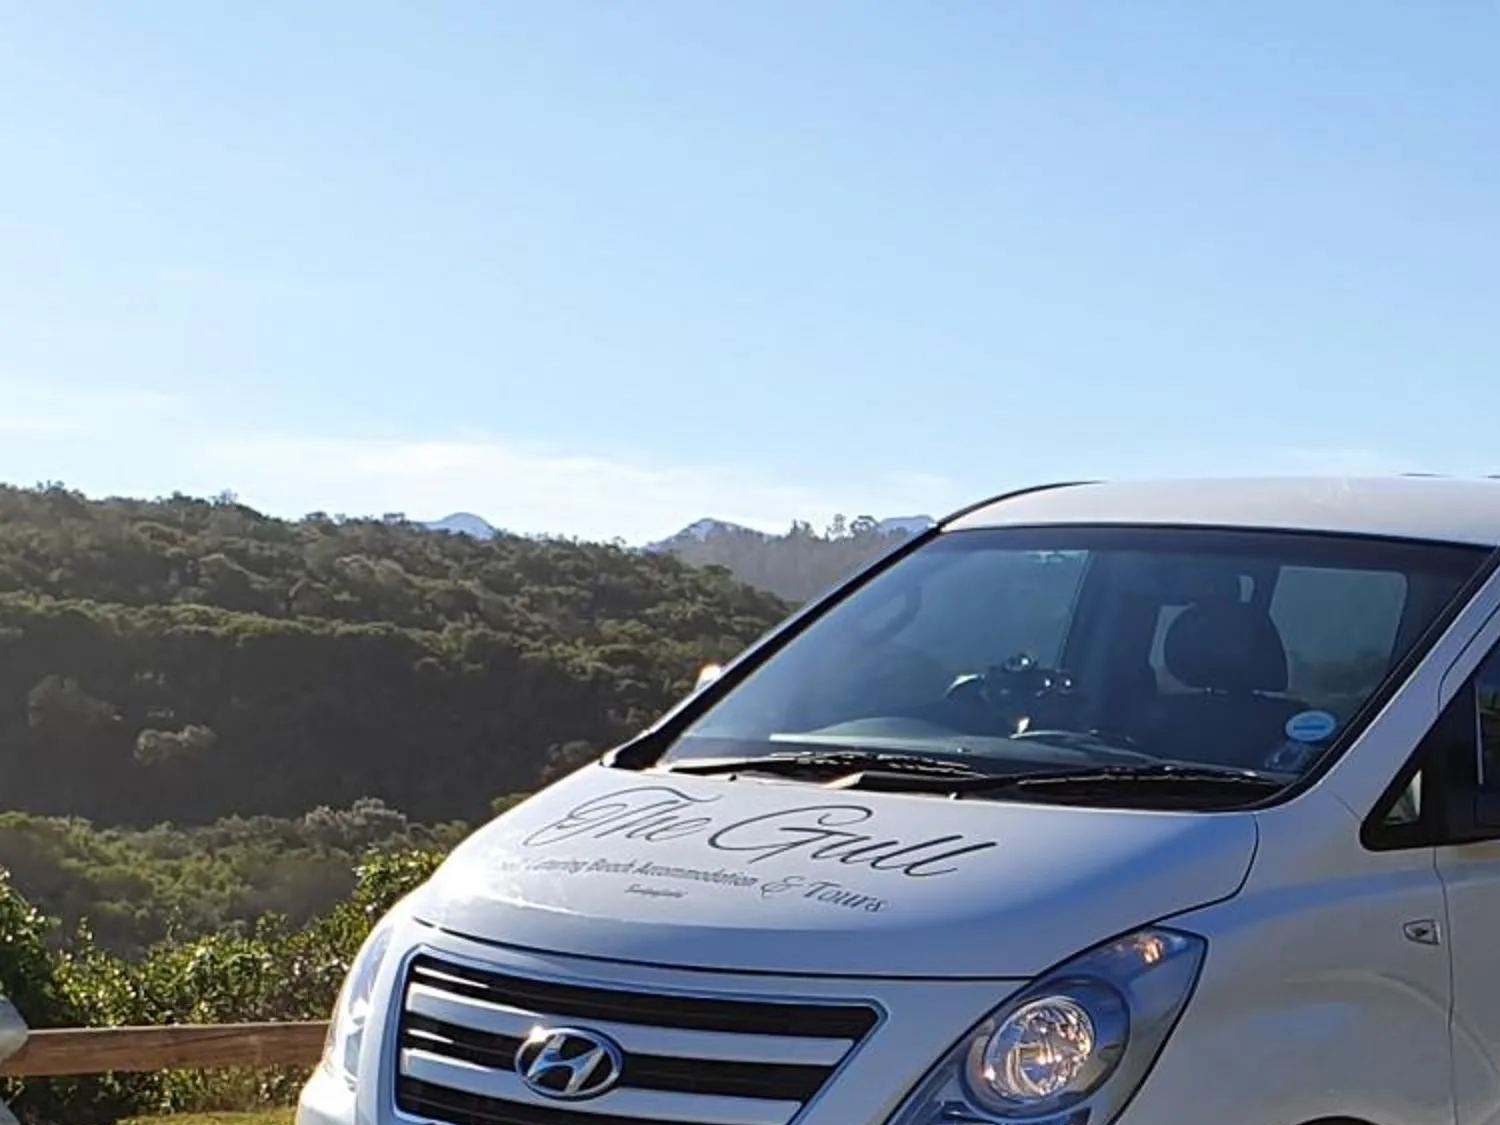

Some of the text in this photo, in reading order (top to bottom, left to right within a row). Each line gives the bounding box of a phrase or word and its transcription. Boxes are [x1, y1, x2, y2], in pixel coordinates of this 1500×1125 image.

[522, 785, 997, 879] The Gull
[803, 881, 888, 913] Tours
